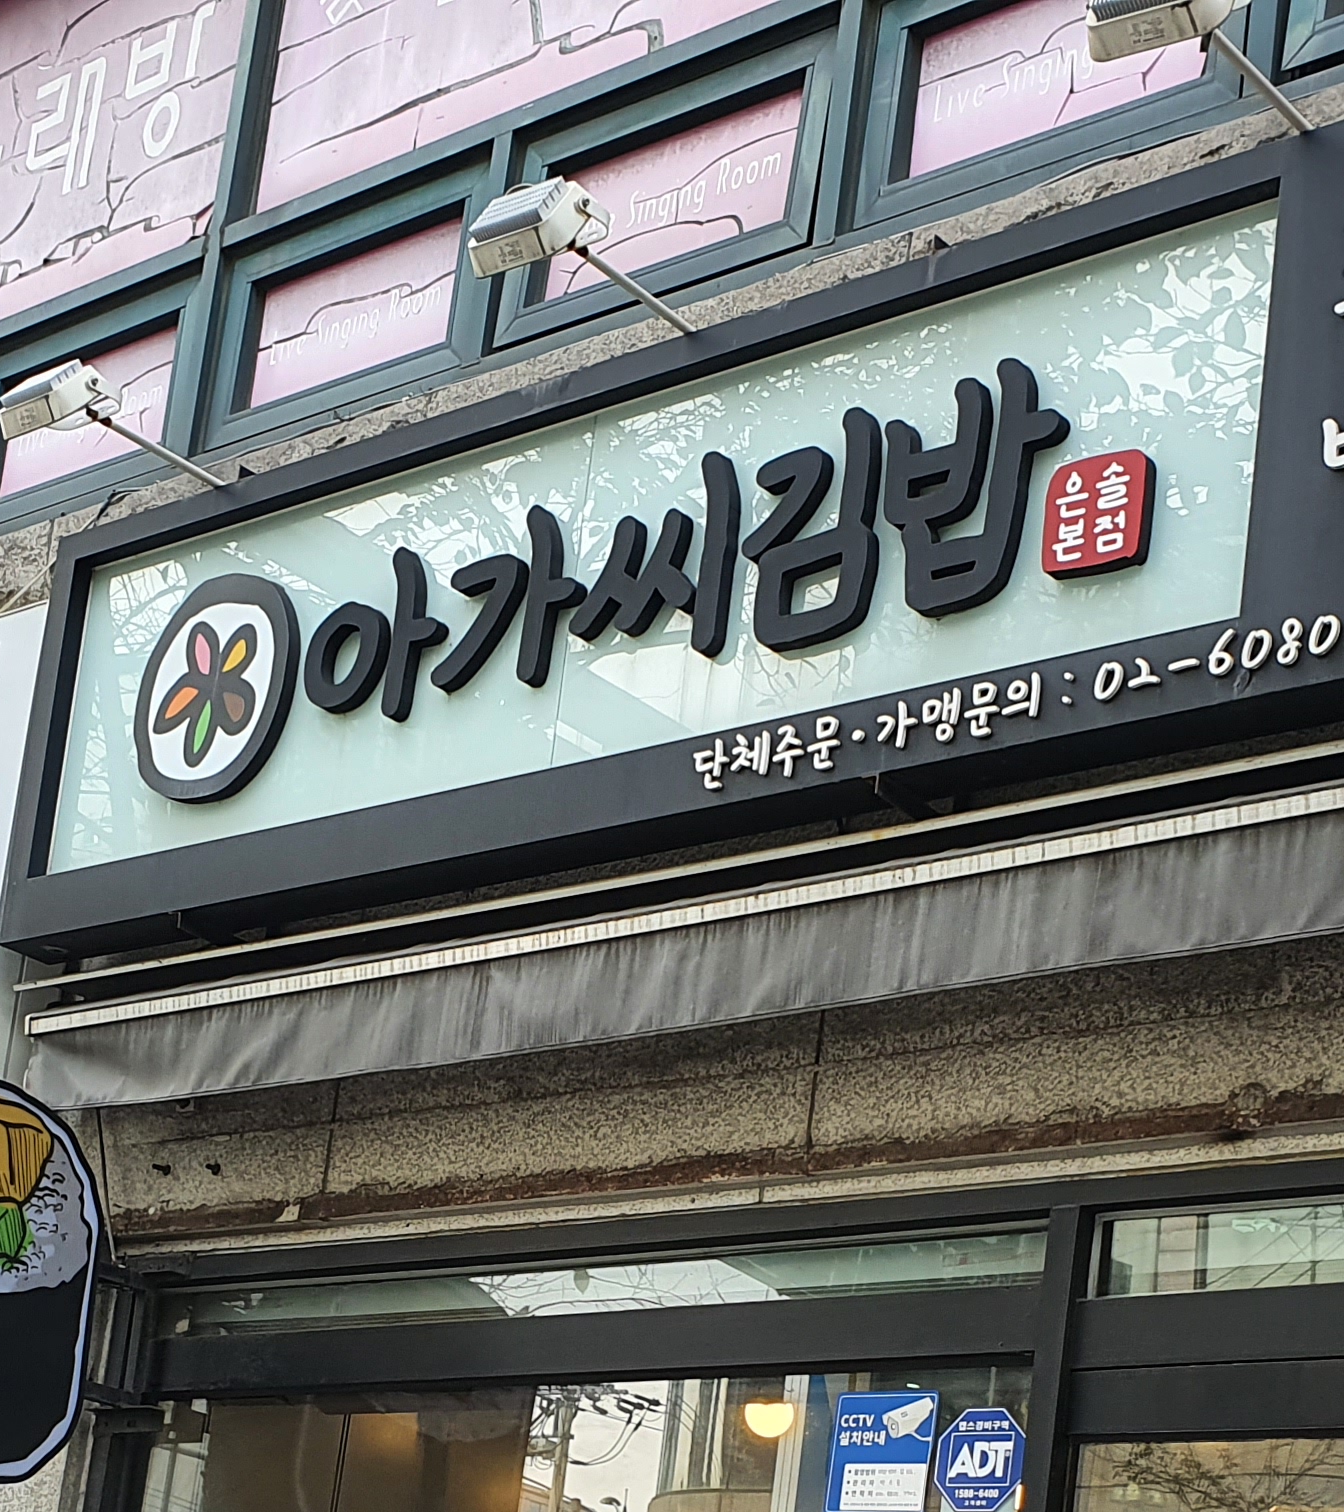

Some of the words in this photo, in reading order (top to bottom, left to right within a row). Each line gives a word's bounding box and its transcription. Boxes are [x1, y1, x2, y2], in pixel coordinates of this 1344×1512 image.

[933, 85, 985, 123] Live
[1001, 42, 1094, 97] Singing
[626, 179, 707, 229] Singing
[716, 152, 782, 195] Room
[268, 331, 307, 367] Live
[314, 300, 381, 351] Singing
[387, 282, 442, 319] Room
[1054, 461, 1131, 518] 은솔
[304, 358, 1071, 722] 아가씨김밥
[1052, 511, 1127, 563] 본점
[838, 1429, 887, 1447] 설치안내
[840, 1413, 875, 1428] CCTV
[958, 1420, 1010, 1432] 캡스경비구역
[948, 1440, 1014, 1479] ADT
[954, 1488, 999, 1500] 1588-6400
